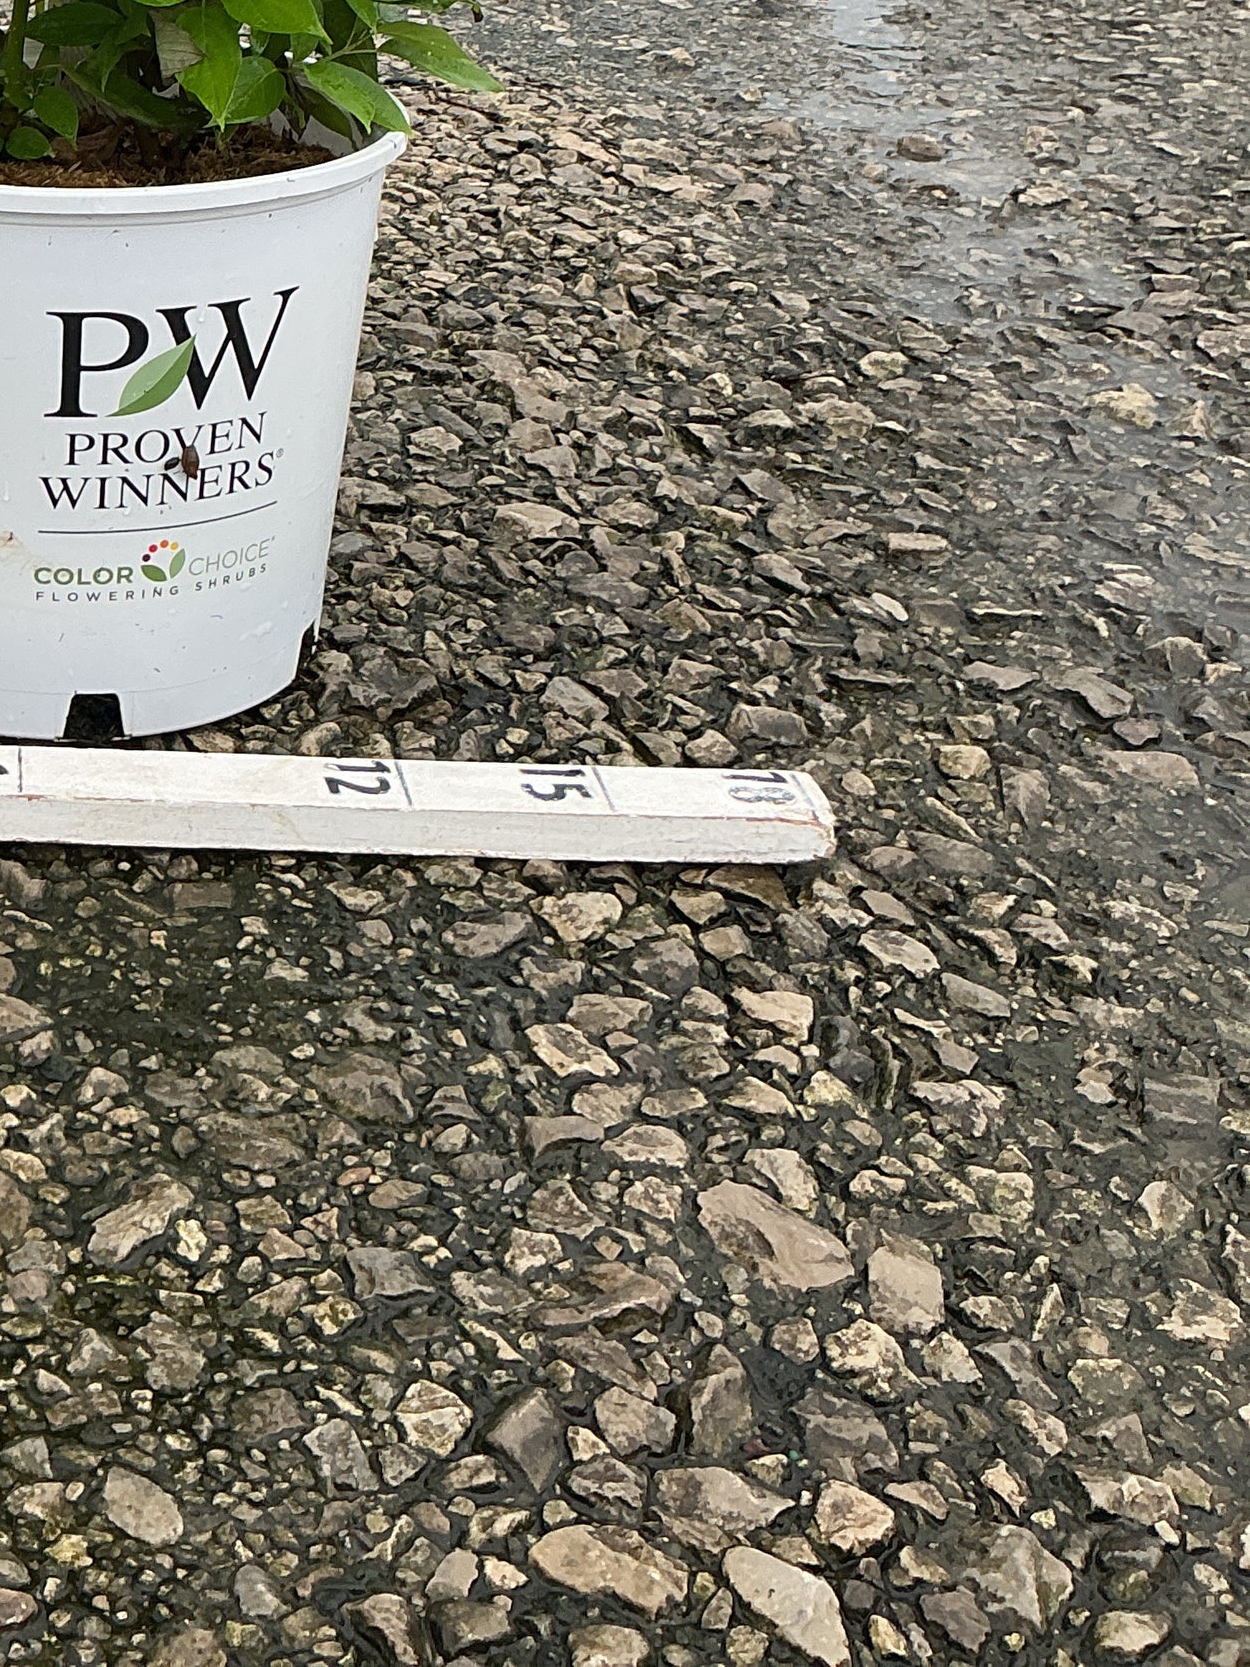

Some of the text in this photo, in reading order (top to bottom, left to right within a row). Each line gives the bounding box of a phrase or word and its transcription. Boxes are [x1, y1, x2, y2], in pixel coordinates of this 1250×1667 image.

[44, 286, 300, 418] PW
[64, 411, 268, 465] PROVEN
[34, 537, 274, 586] COLOR CHOICE
[35, 562, 268, 602] FLOWERING SHRUBS
[324, 760, 392, 795] 12
[519, 768, 594, 801] 15
[721, 771, 796, 805] 18
